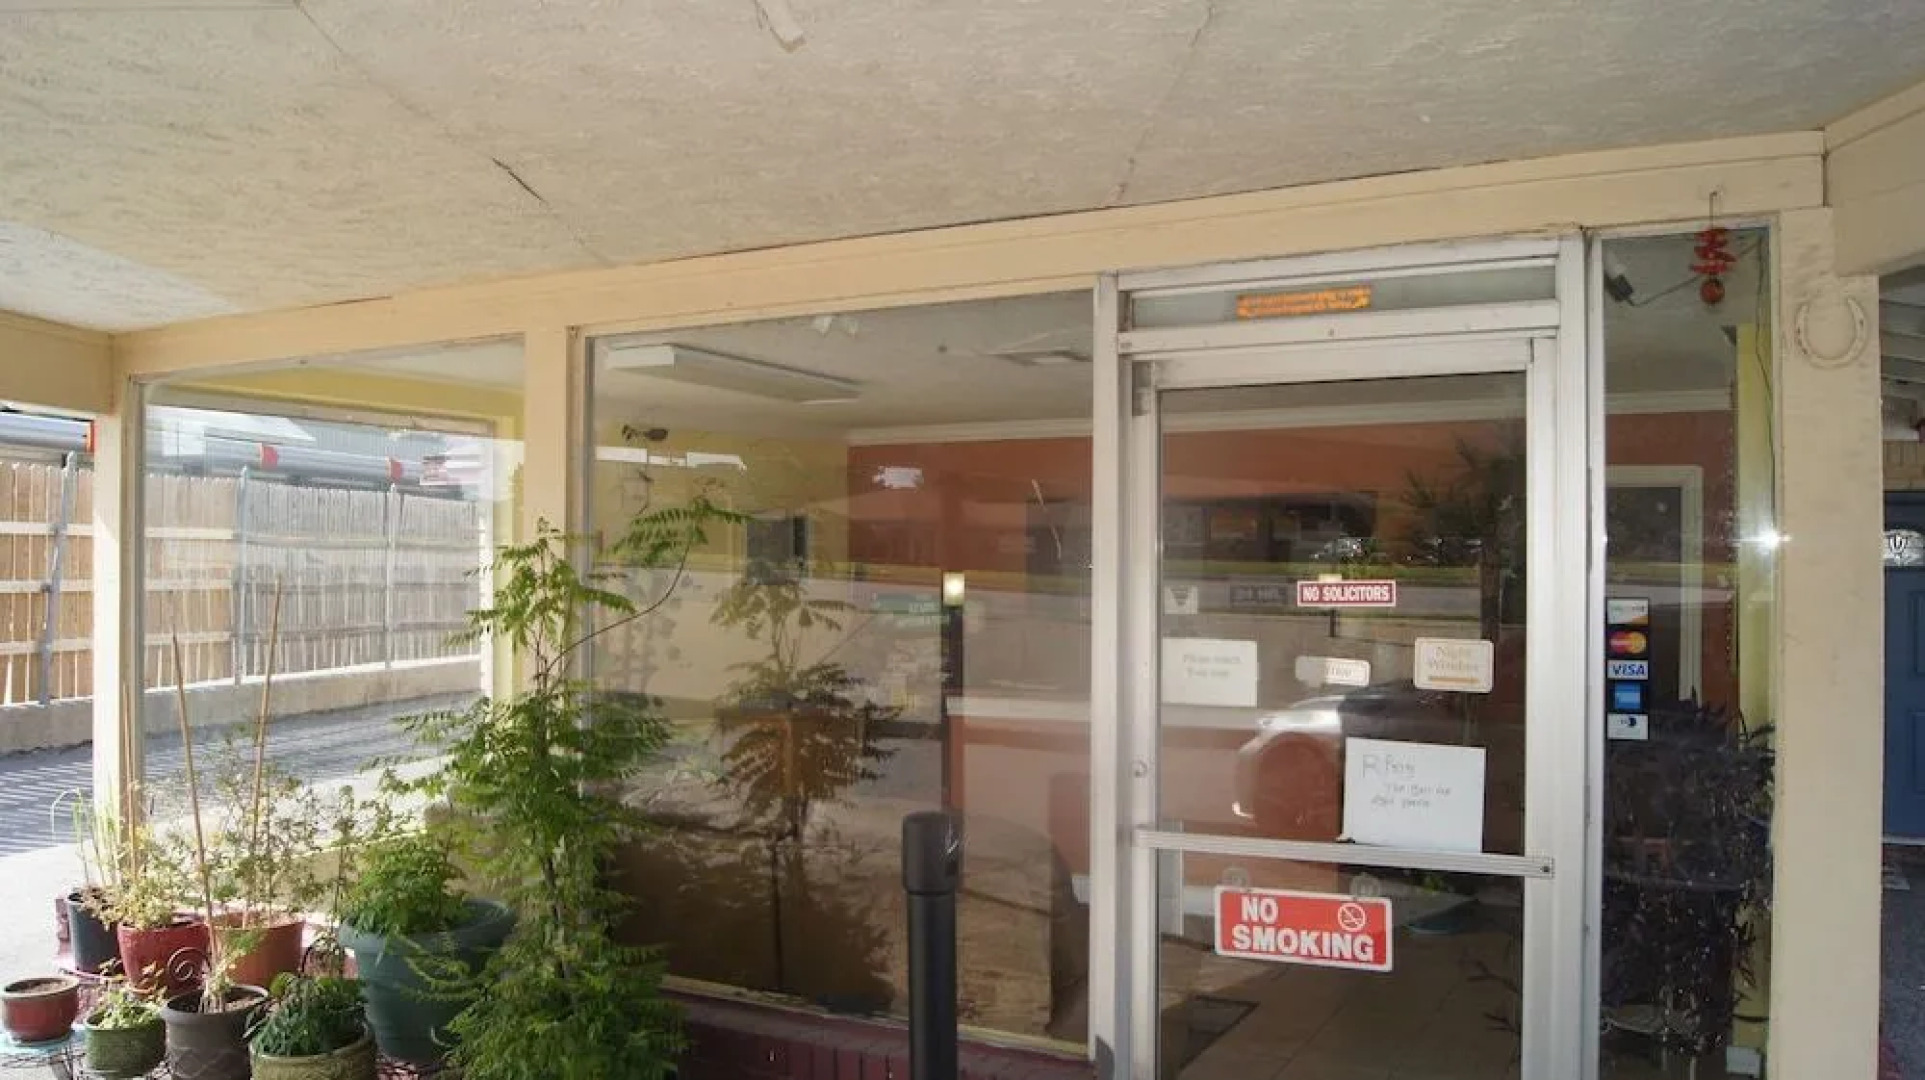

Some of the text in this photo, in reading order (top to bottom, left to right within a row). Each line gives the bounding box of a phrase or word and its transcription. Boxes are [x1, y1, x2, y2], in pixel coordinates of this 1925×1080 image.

[1302, 585, 1320, 602] NO
[1322, 584, 1390, 602] SOLICITORS
[1612, 663, 1646, 676] VISA
[1241, 896, 1279, 925] NO
[1232, 923, 1374, 963] SMOKING
